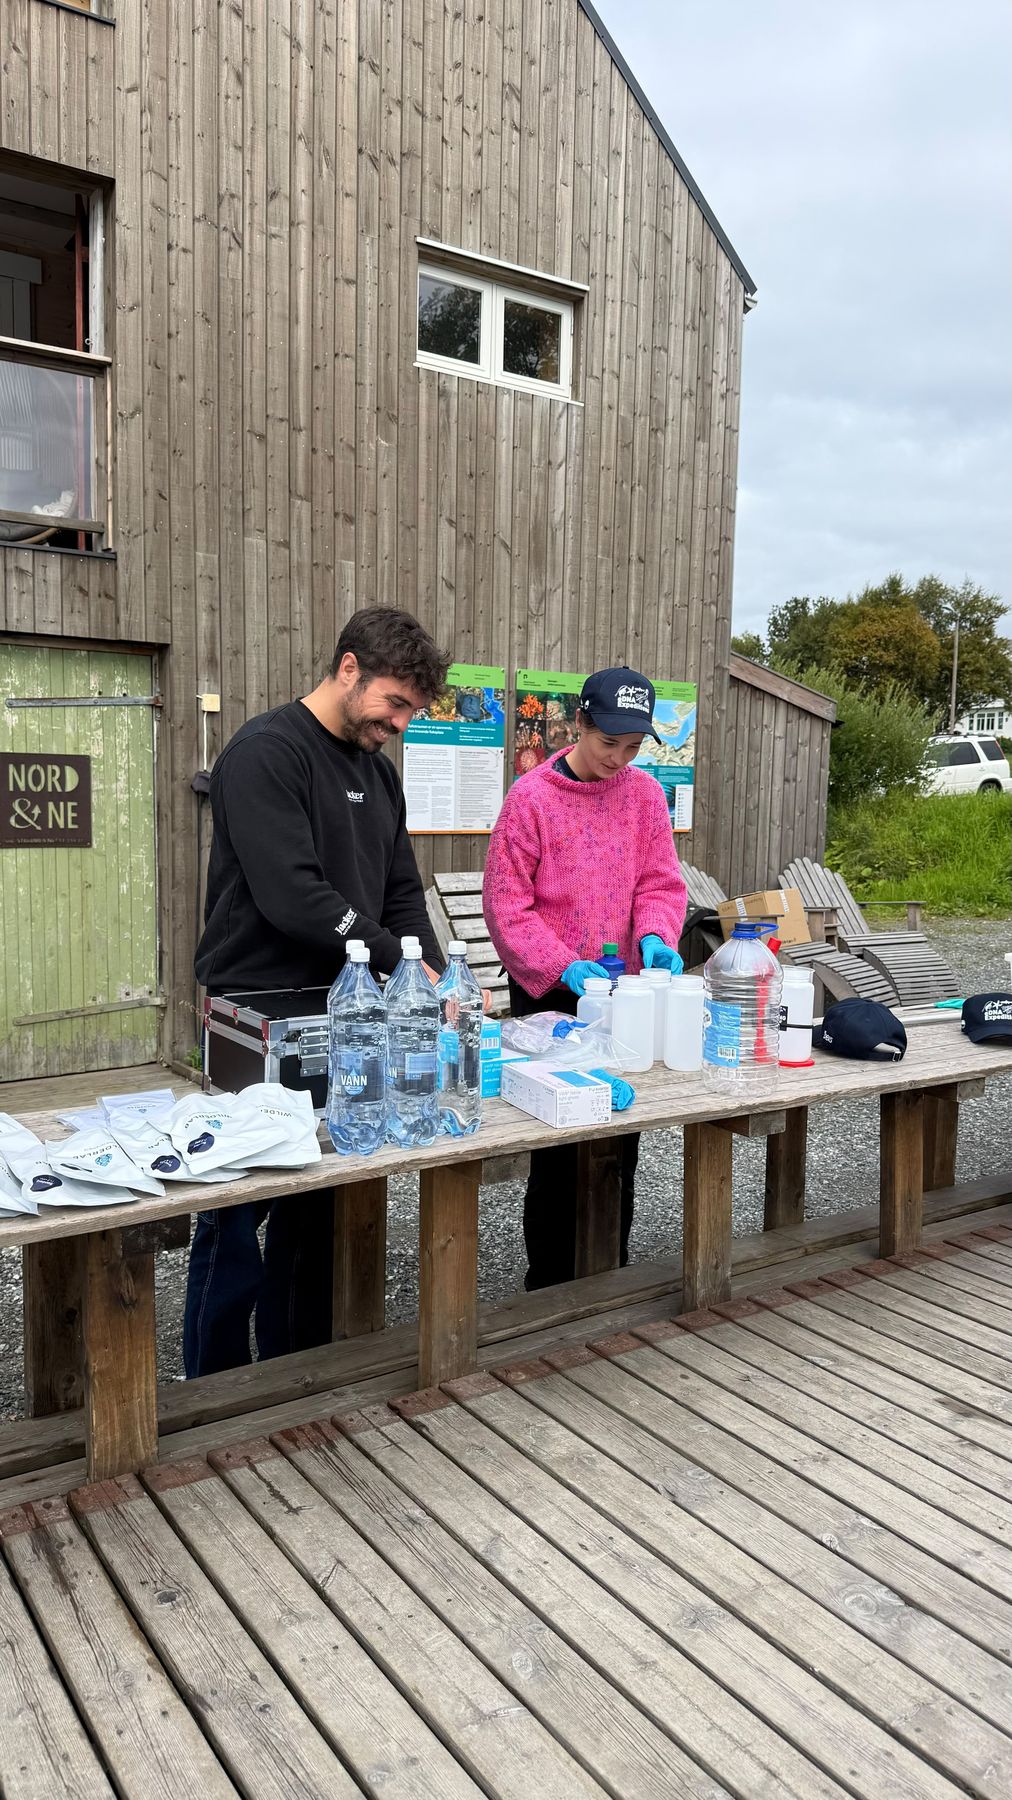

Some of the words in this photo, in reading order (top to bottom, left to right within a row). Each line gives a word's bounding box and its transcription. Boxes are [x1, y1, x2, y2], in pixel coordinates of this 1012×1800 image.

[8, 763, 80, 793] NORD
[9, 797, 42, 830] &
[47, 801, 79, 829] NE
[341, 1074, 368, 1086] VANN
